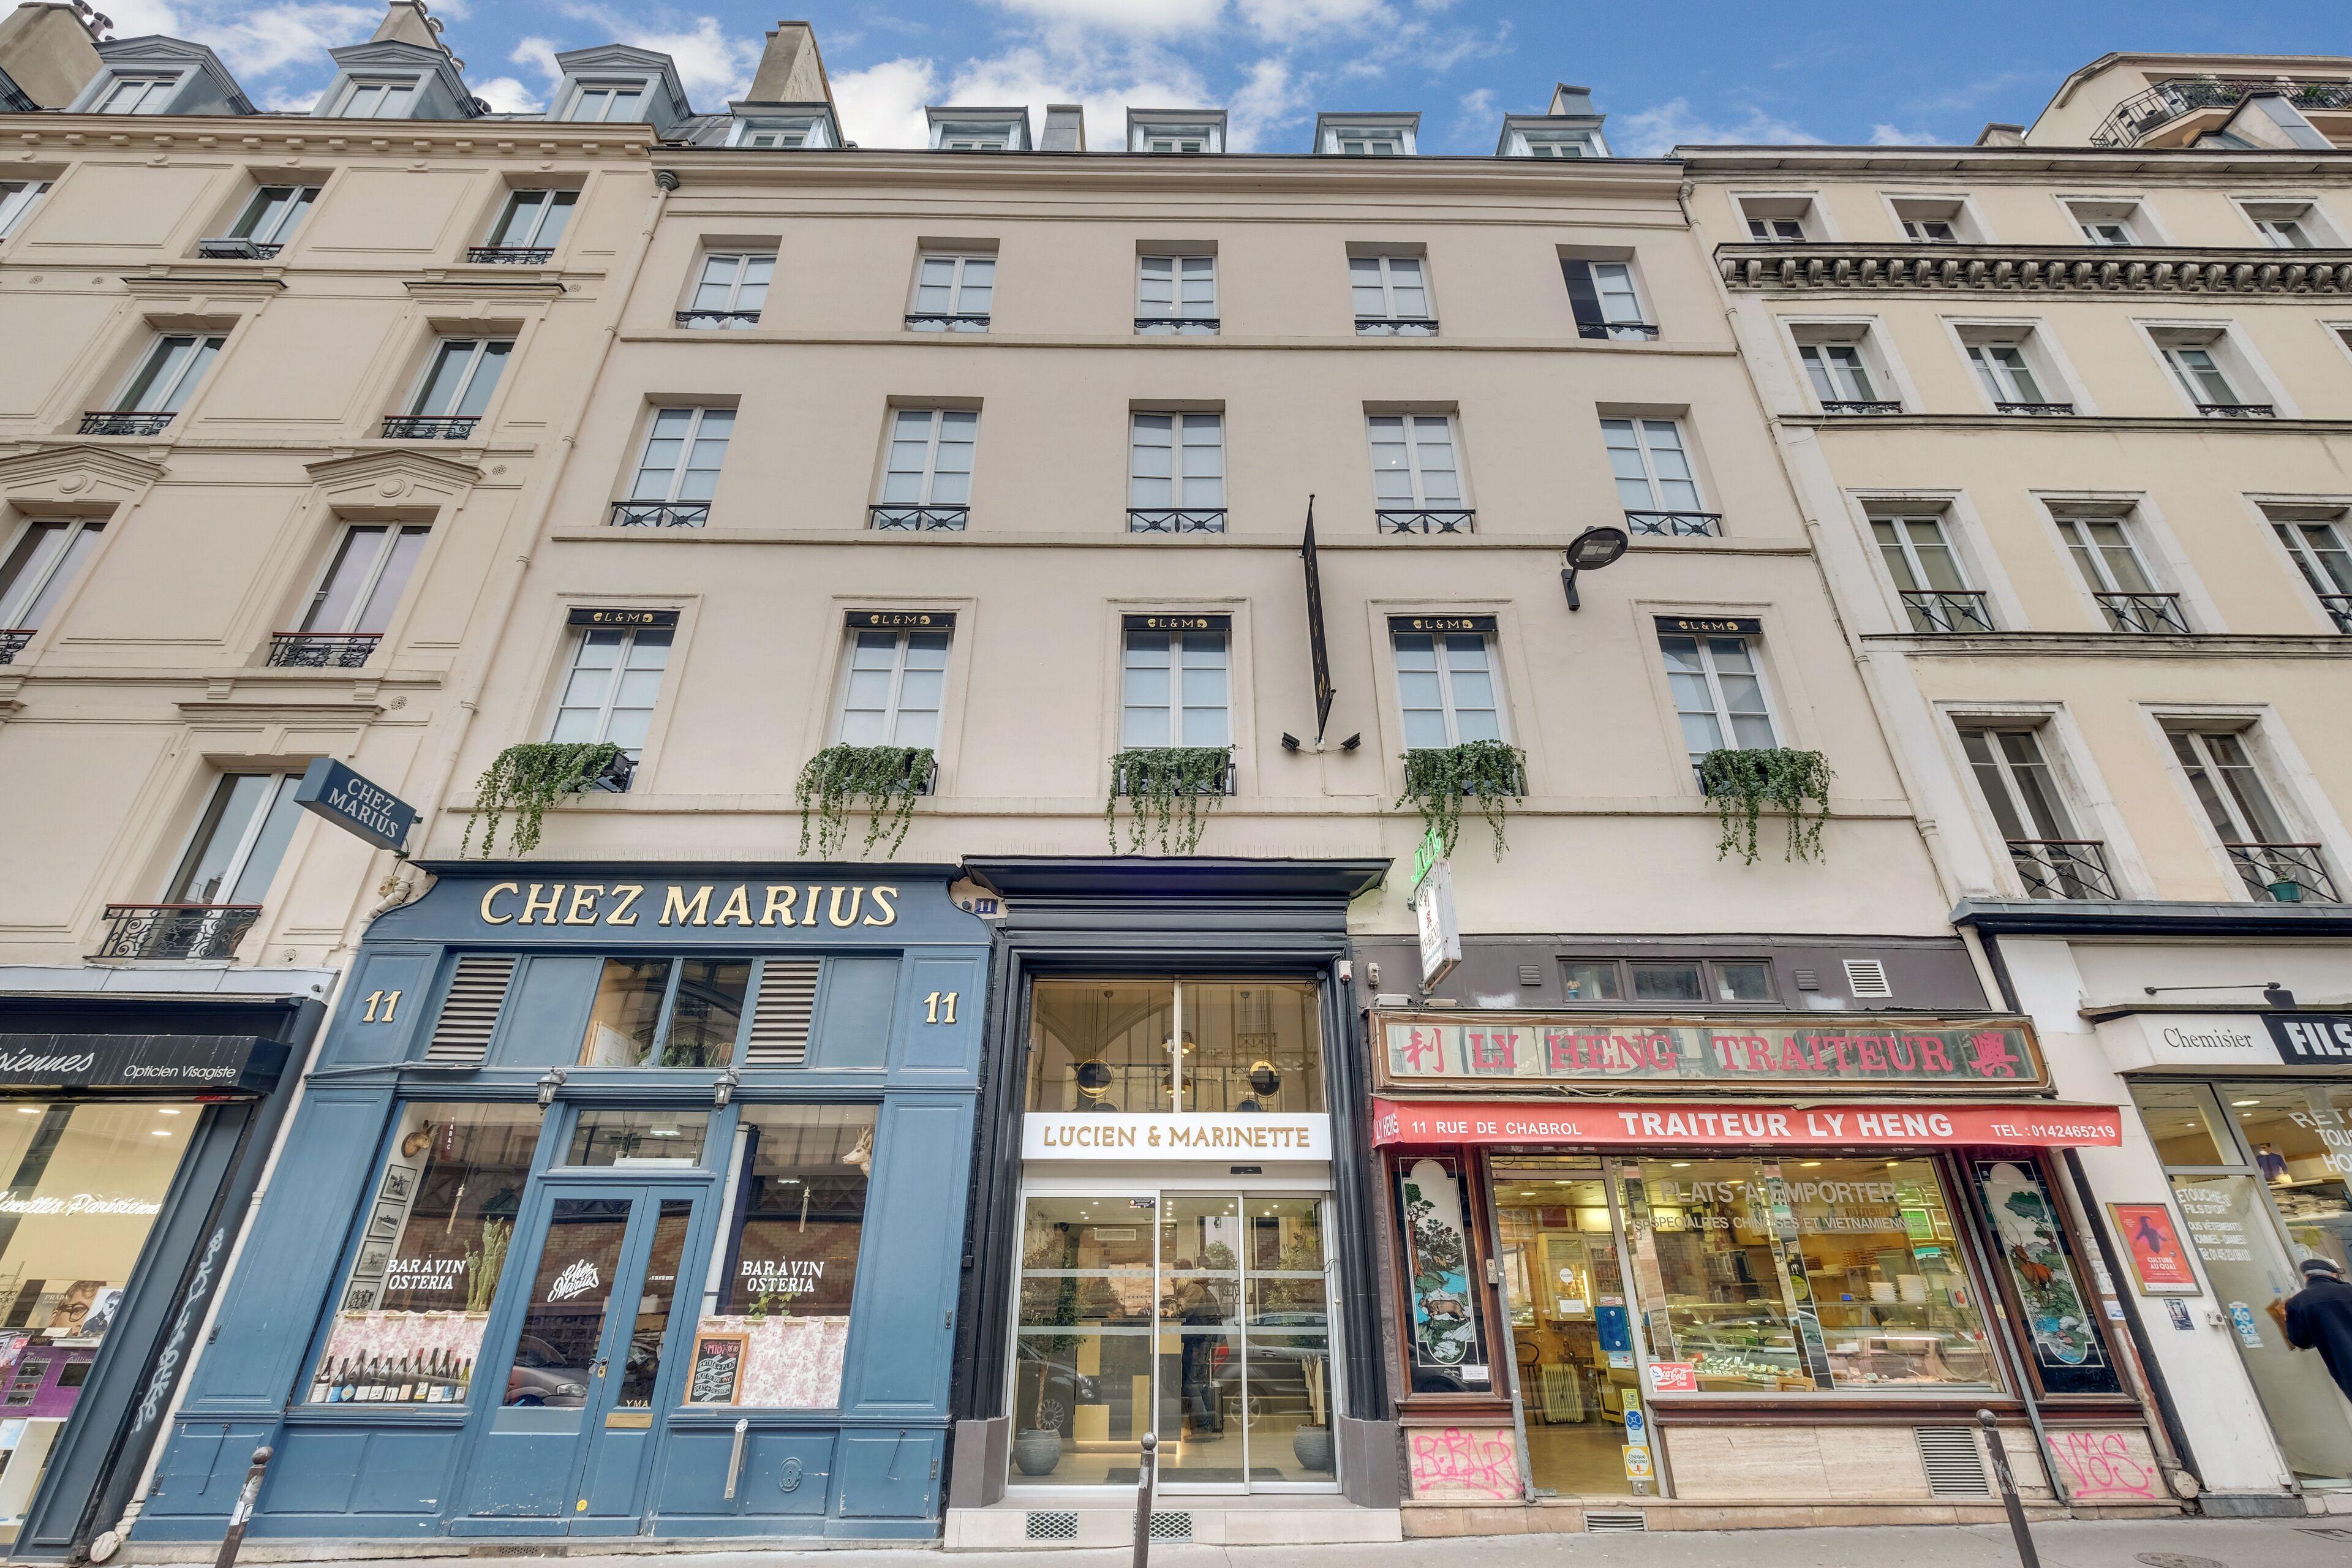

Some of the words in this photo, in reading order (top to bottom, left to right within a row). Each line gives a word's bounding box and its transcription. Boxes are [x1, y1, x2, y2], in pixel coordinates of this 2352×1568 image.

[347, 778, 396, 816] CHEZ
[328, 788, 398, 838] MARIUS
[480, 883, 644, 926] CHEZ
[658, 884, 899, 927] MARIUS
[979, 900, 992, 911] 11
[363, 990, 402, 1023] 11
[923, 991, 959, 1024] 11
[2164, 1028, 2252, 1048] Chemisier
[0, 1047, 95, 1072] siennes
[1401, 1027, 1446, 1074] 利
[1469, 1032, 1519, 1069] LY
[1545, 1033, 1678, 1071] HENG
[1712, 1035, 1954, 1072] TRAITEUR
[124, 1065, 178, 1079] Opticien
[182, 1065, 236, 1080] Visagiste
[1376, 1118, 1382, 1139] LY
[1382, 1112, 1400, 1137] HENG
[1412, 1121, 1426, 1133] 11
[1436, 1121, 1468, 1134] RUE
[1476, 1121, 1498, 1134] DE
[1505, 1121, 1582, 1136] CHABROL
[1618, 1112, 1787, 1136] TRAITEUR
[1808, 1114, 1844, 1137] LY
[1856, 1113, 1953, 1137] HENG
[2288, 1108, 2352, 1128] RET
[1044, 1126, 1136, 1147] LUCIEN
[1147, 1125, 1161, 1147] &
[1169, 1126, 1310, 1147] MARINETTE
[2031, 1125, 2116, 1137] 0142465219
[2315, 1129, 2352, 1147] TOU
[2321, 1154, 2352, 1172] HO
[1659, 1181, 1734, 1203] PLATS
[1768, 1181, 1898, 1204] EMPORTER
[386, 1259, 421, 1273] BAR
[435, 1259, 466, 1275] VIN
[741, 1259, 775, 1276] BAR
[791, 1261, 824, 1279] VIN
[388, 1275, 453, 1290] OSTERIA
[747, 1277, 815, 1292] OSTERIA
